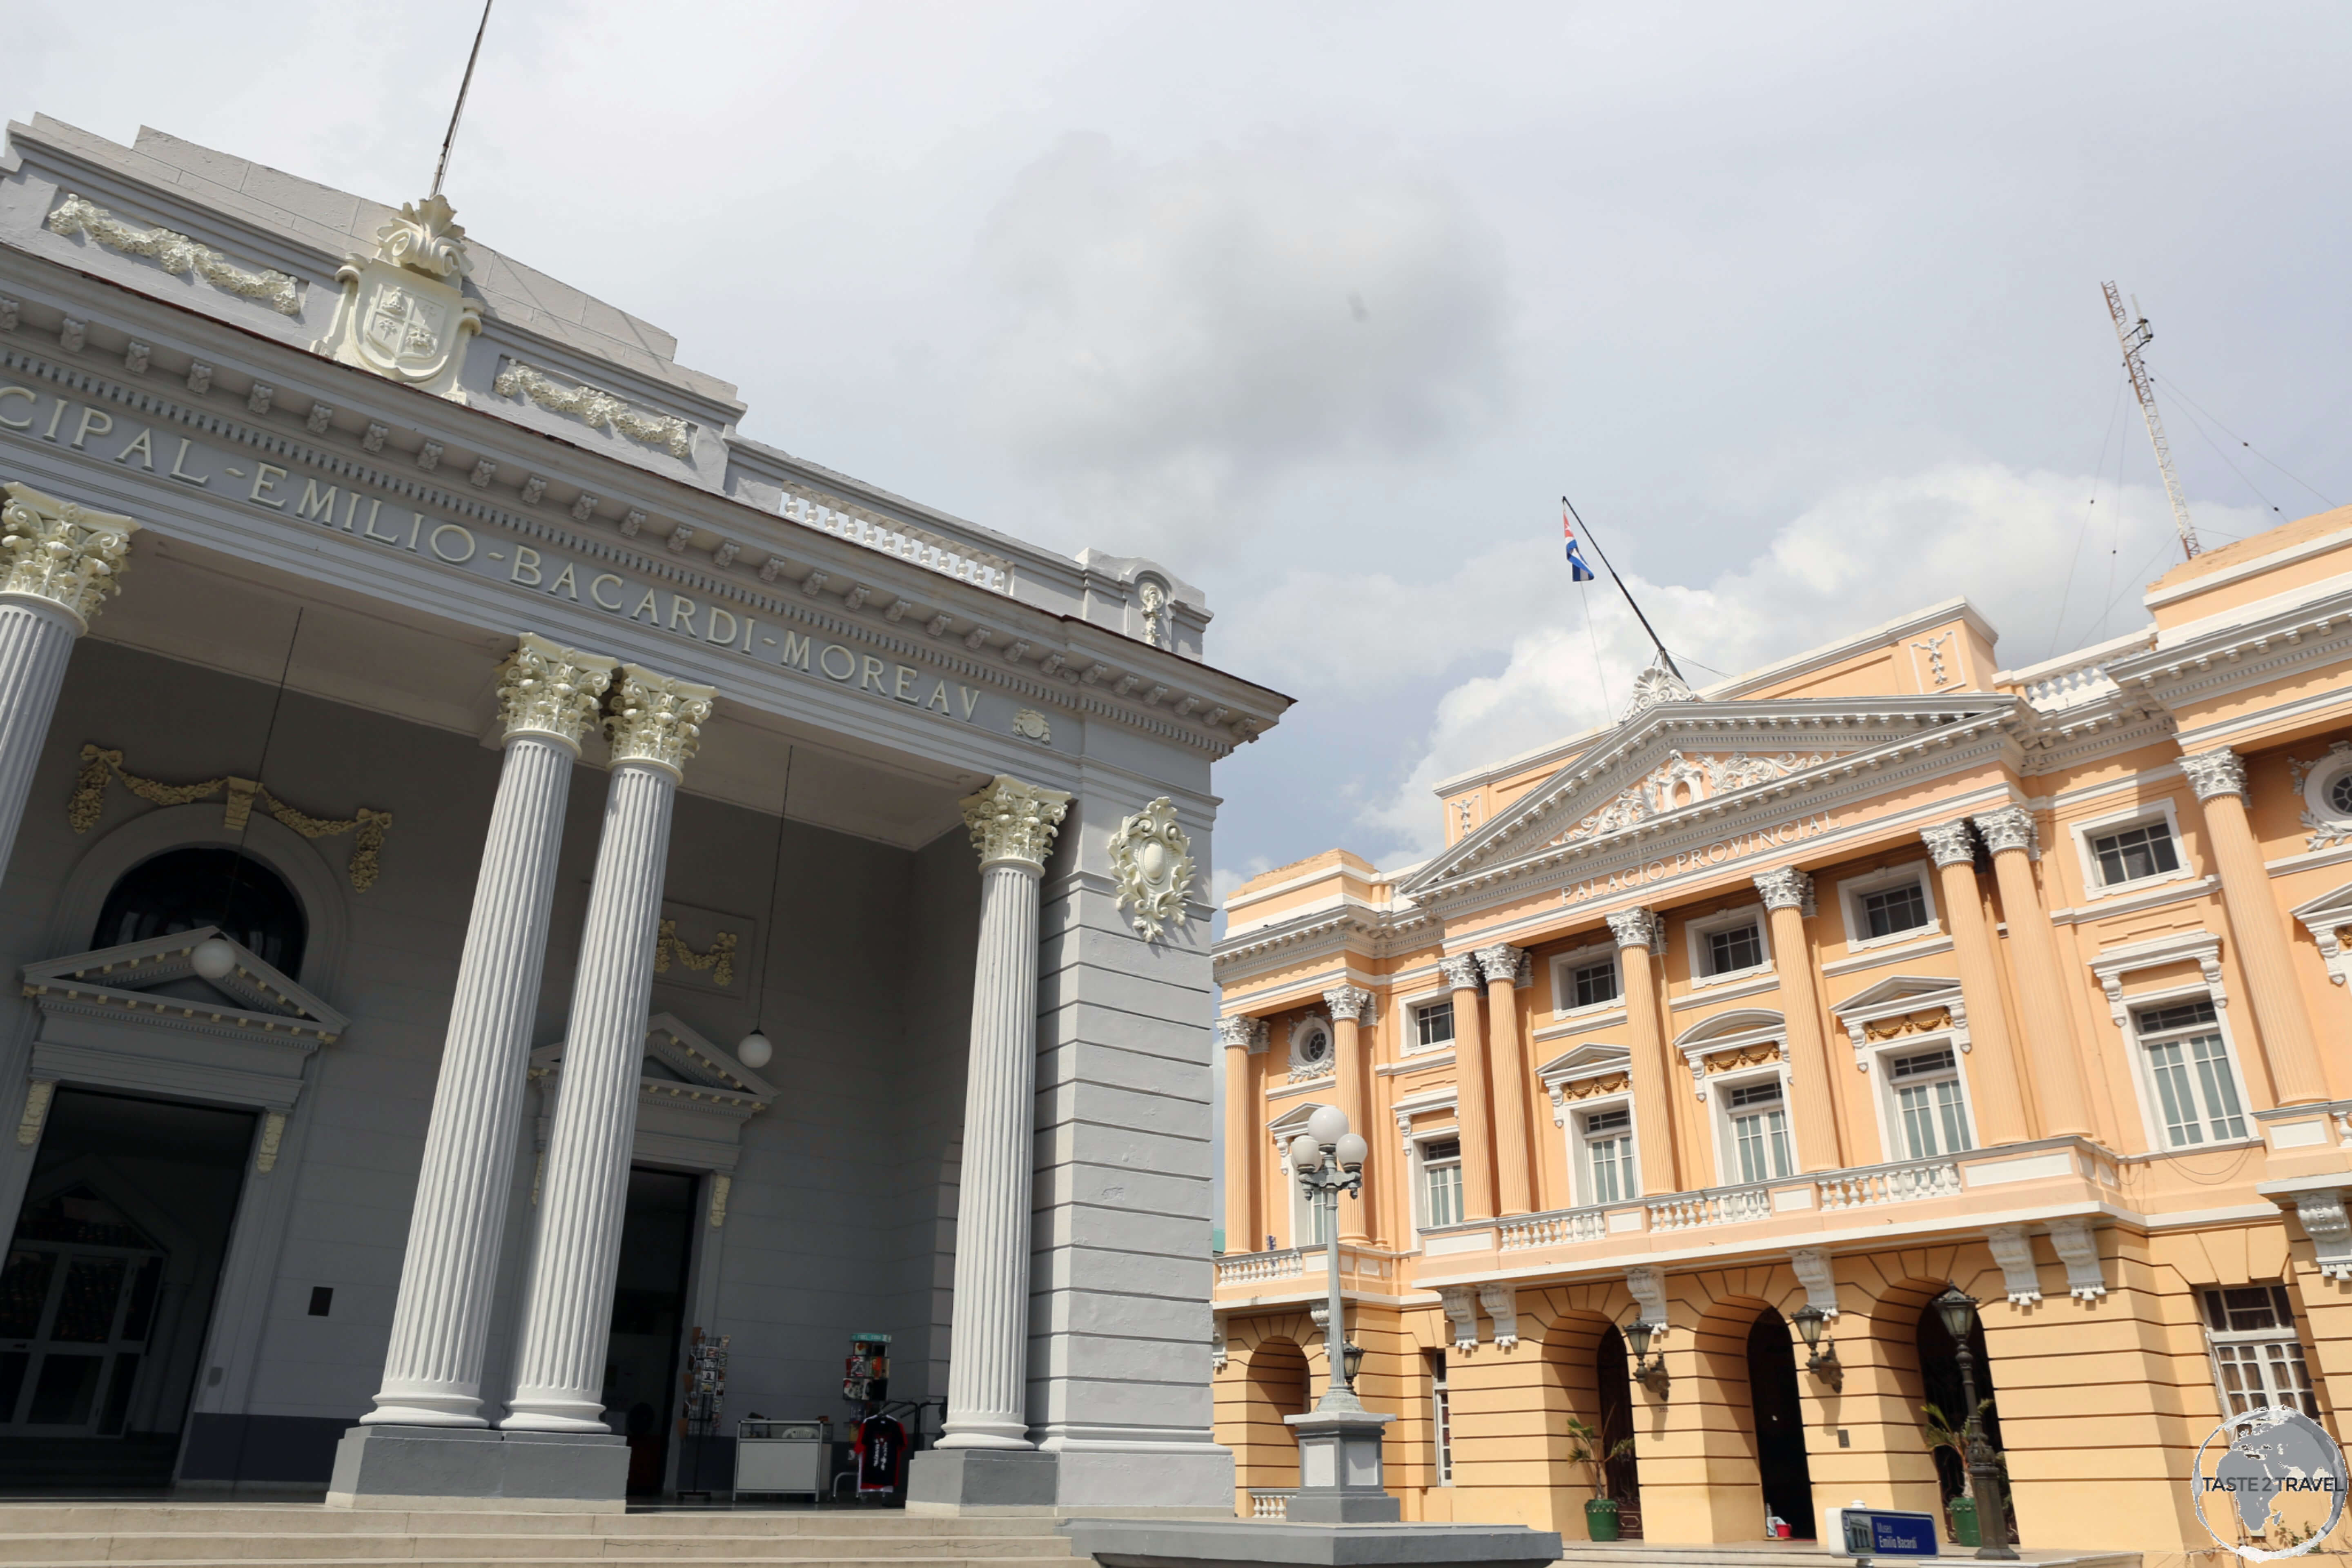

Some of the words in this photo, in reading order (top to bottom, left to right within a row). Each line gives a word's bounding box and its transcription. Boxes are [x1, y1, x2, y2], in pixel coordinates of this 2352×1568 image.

[1562, 861, 1665, 905] PALACIO
[1676, 810, 1840, 874] PROVINCIAL
[1876, 1522, 1892, 1533] Museo
[1879, 1536, 1897, 1548] Emilio
